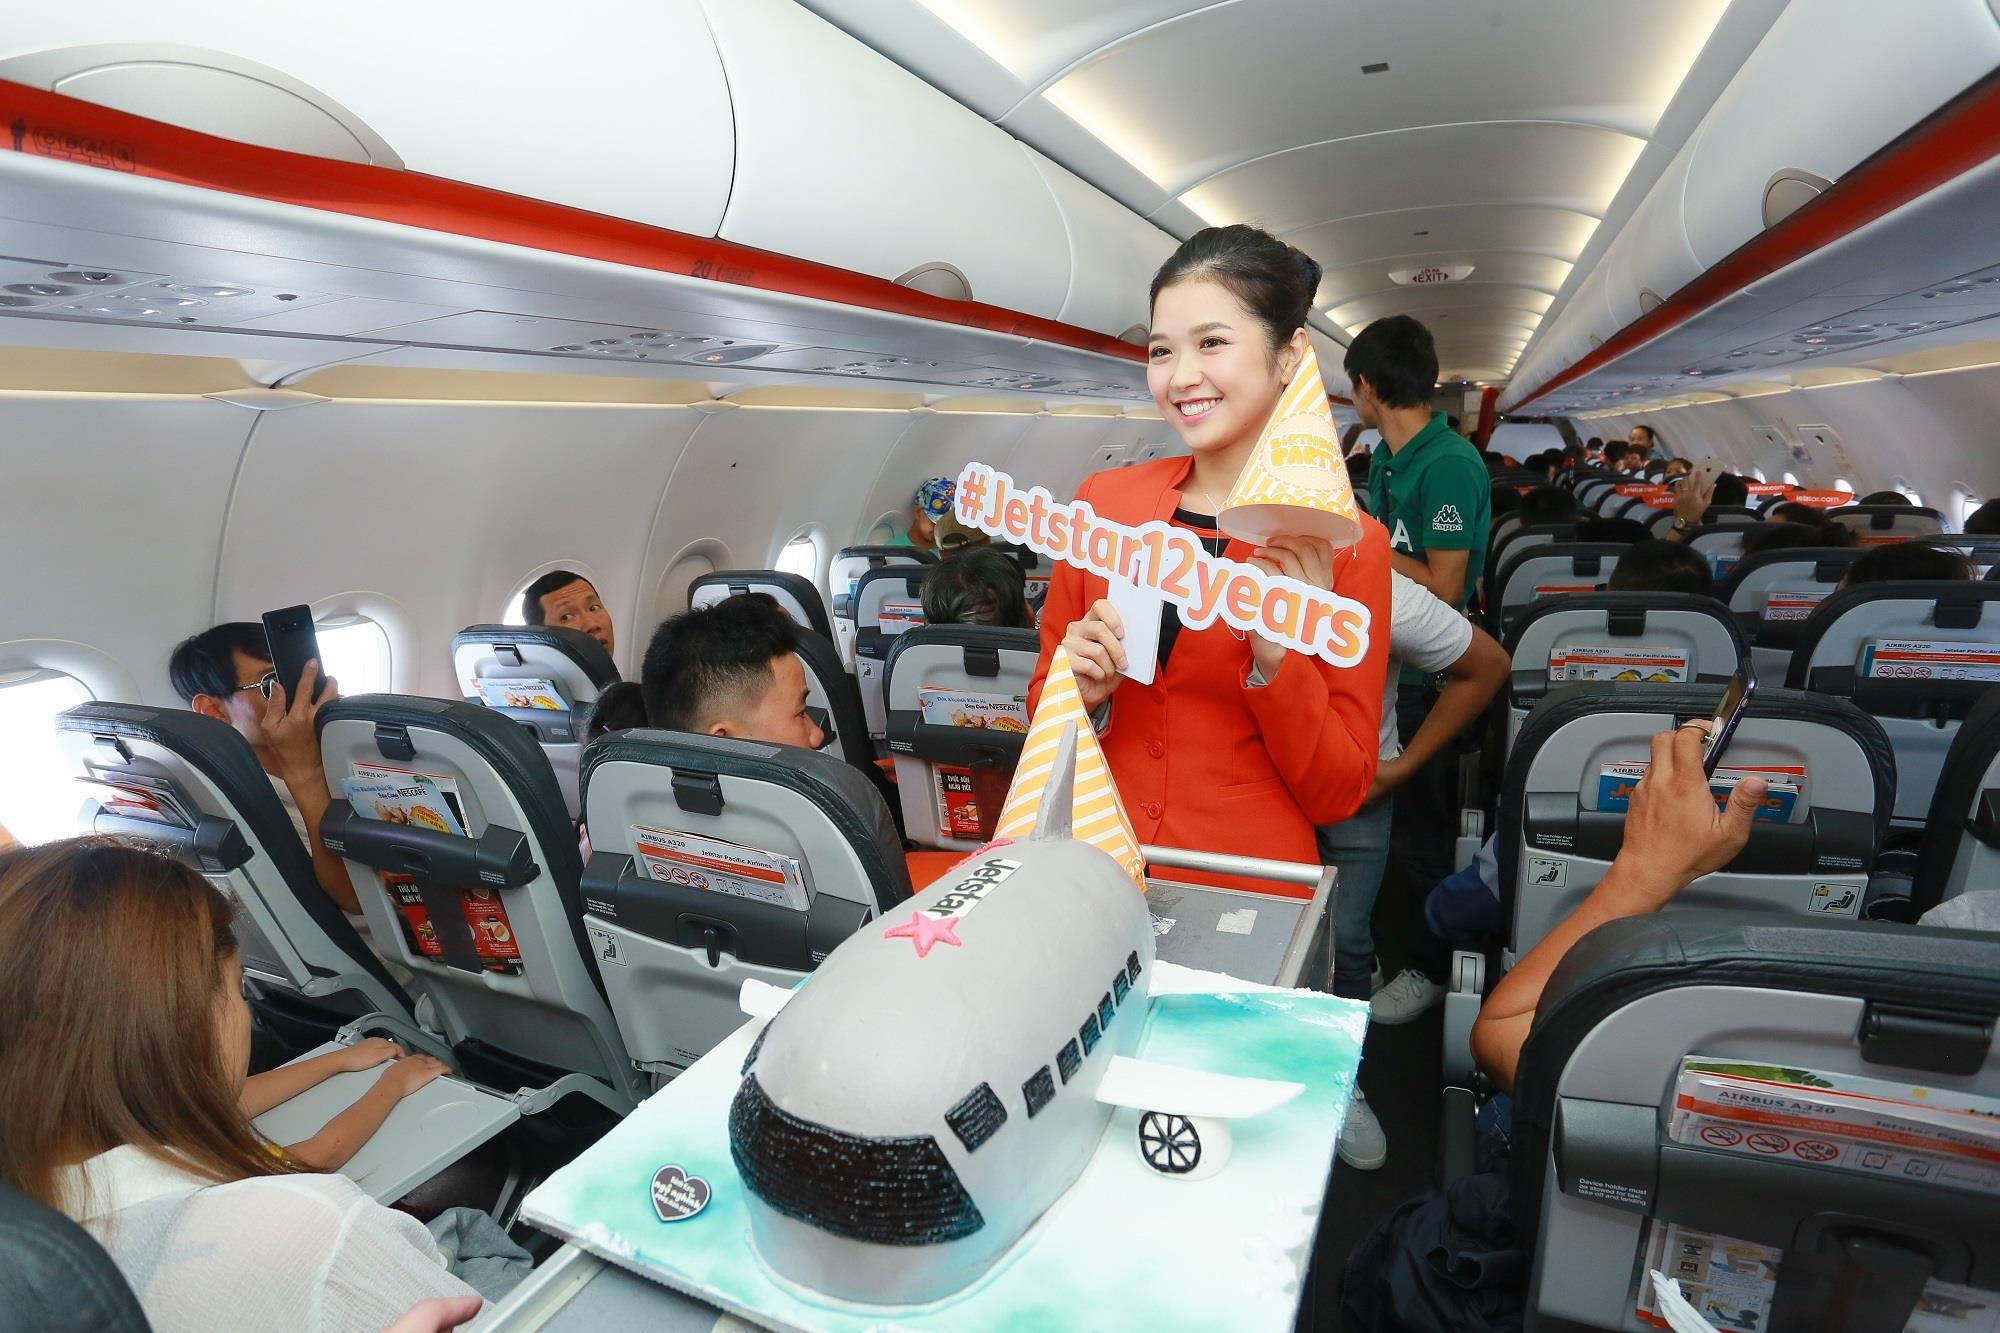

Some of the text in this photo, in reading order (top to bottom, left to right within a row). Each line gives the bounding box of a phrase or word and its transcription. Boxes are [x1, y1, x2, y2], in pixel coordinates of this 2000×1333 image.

[1418, 272, 1443, 283] EXIT
[1271, 446, 1341, 475] PARTY
[1432, 522, 1463, 532] Kappa
[960, 470, 1363, 659] #Jetstar12years
[988, 703, 1022, 712] NESCAFÉ
[358, 770, 376, 778] AIRBUS
[397, 785, 428, 798] NESCAFÉ
[640, 833, 666, 844] AIRBUS
[667, 839, 686, 848] A320
[701, 850, 723, 860] Jetstar
[723, 854, 746, 865] Pacific
[747, 859, 773, 870] Airlines
[927, 859, 1016, 917] Jetstar
[1718, 1091, 1785, 1107] AIRBUS
[1790, 1102, 1836, 1114] A320
[1579, 1178, 1647, 1195] Device holder must
[1620, 1196, 1647, 1207] landing
